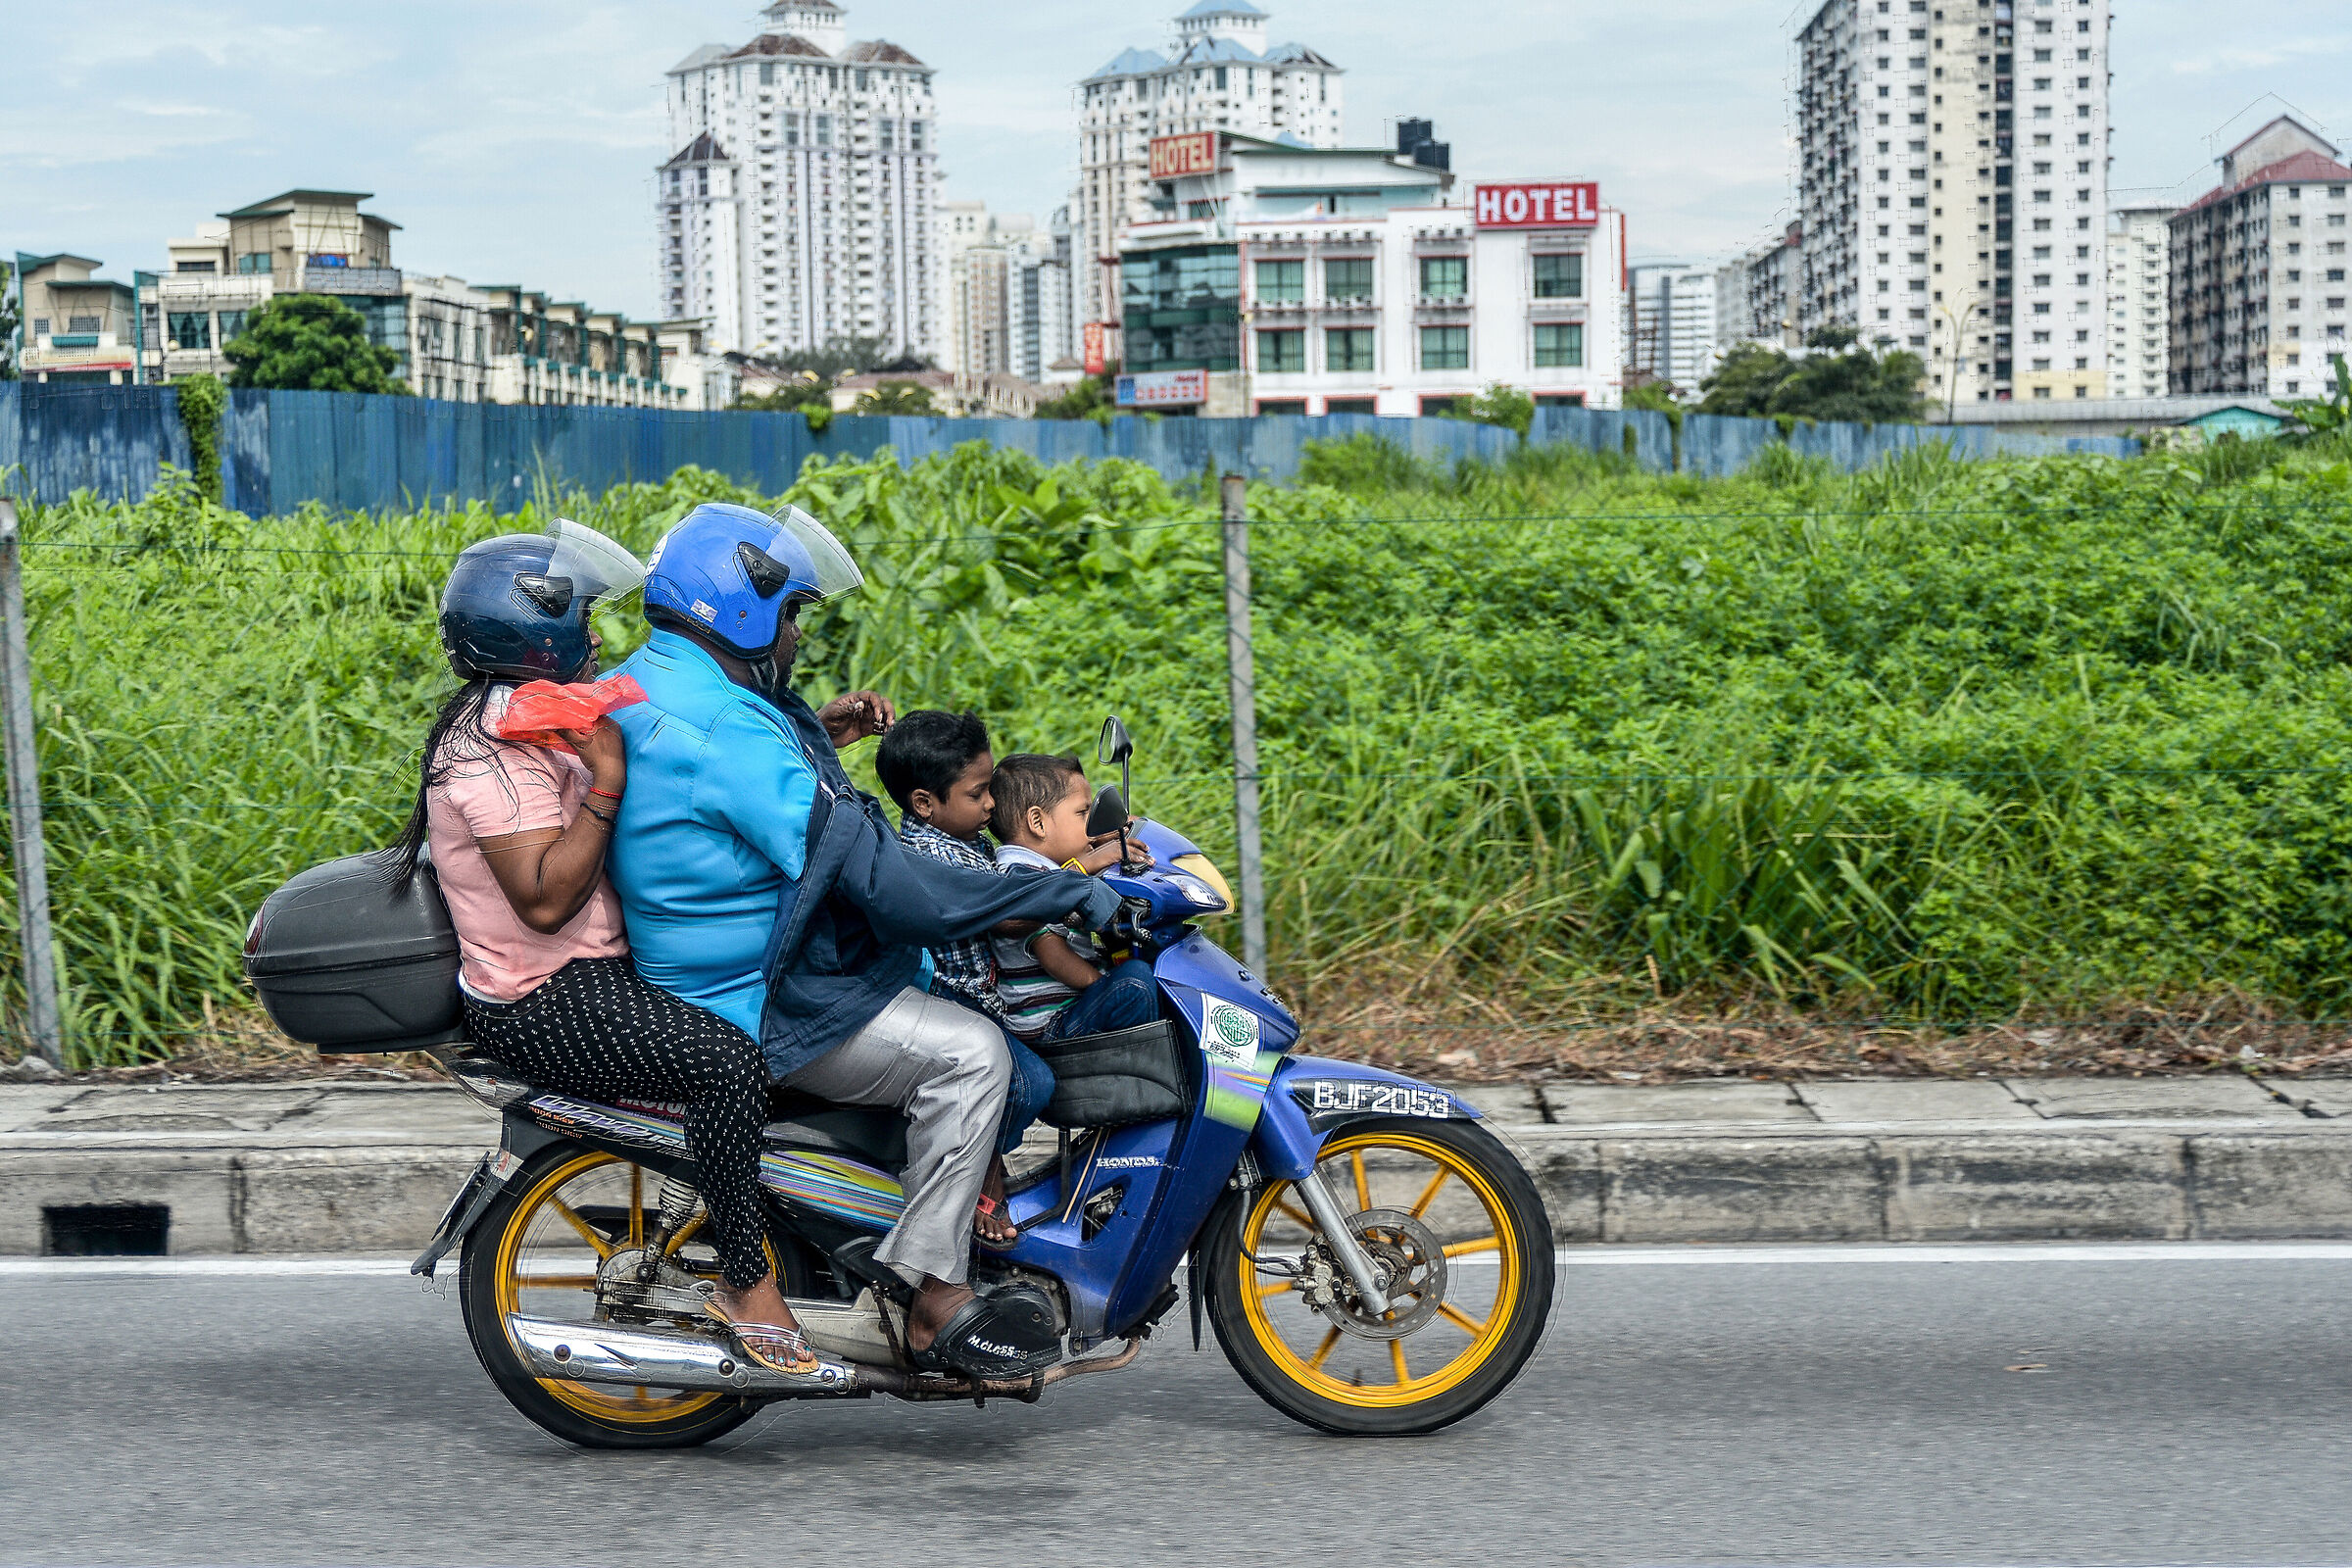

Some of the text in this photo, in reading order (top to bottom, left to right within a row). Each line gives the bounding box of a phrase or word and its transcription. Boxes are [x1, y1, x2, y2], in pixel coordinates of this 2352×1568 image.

[1152, 136, 1211, 173] HOTEL
[1478, 187, 1595, 222] HOTEL
[1097, 1156, 1158, 1169] HONDA
